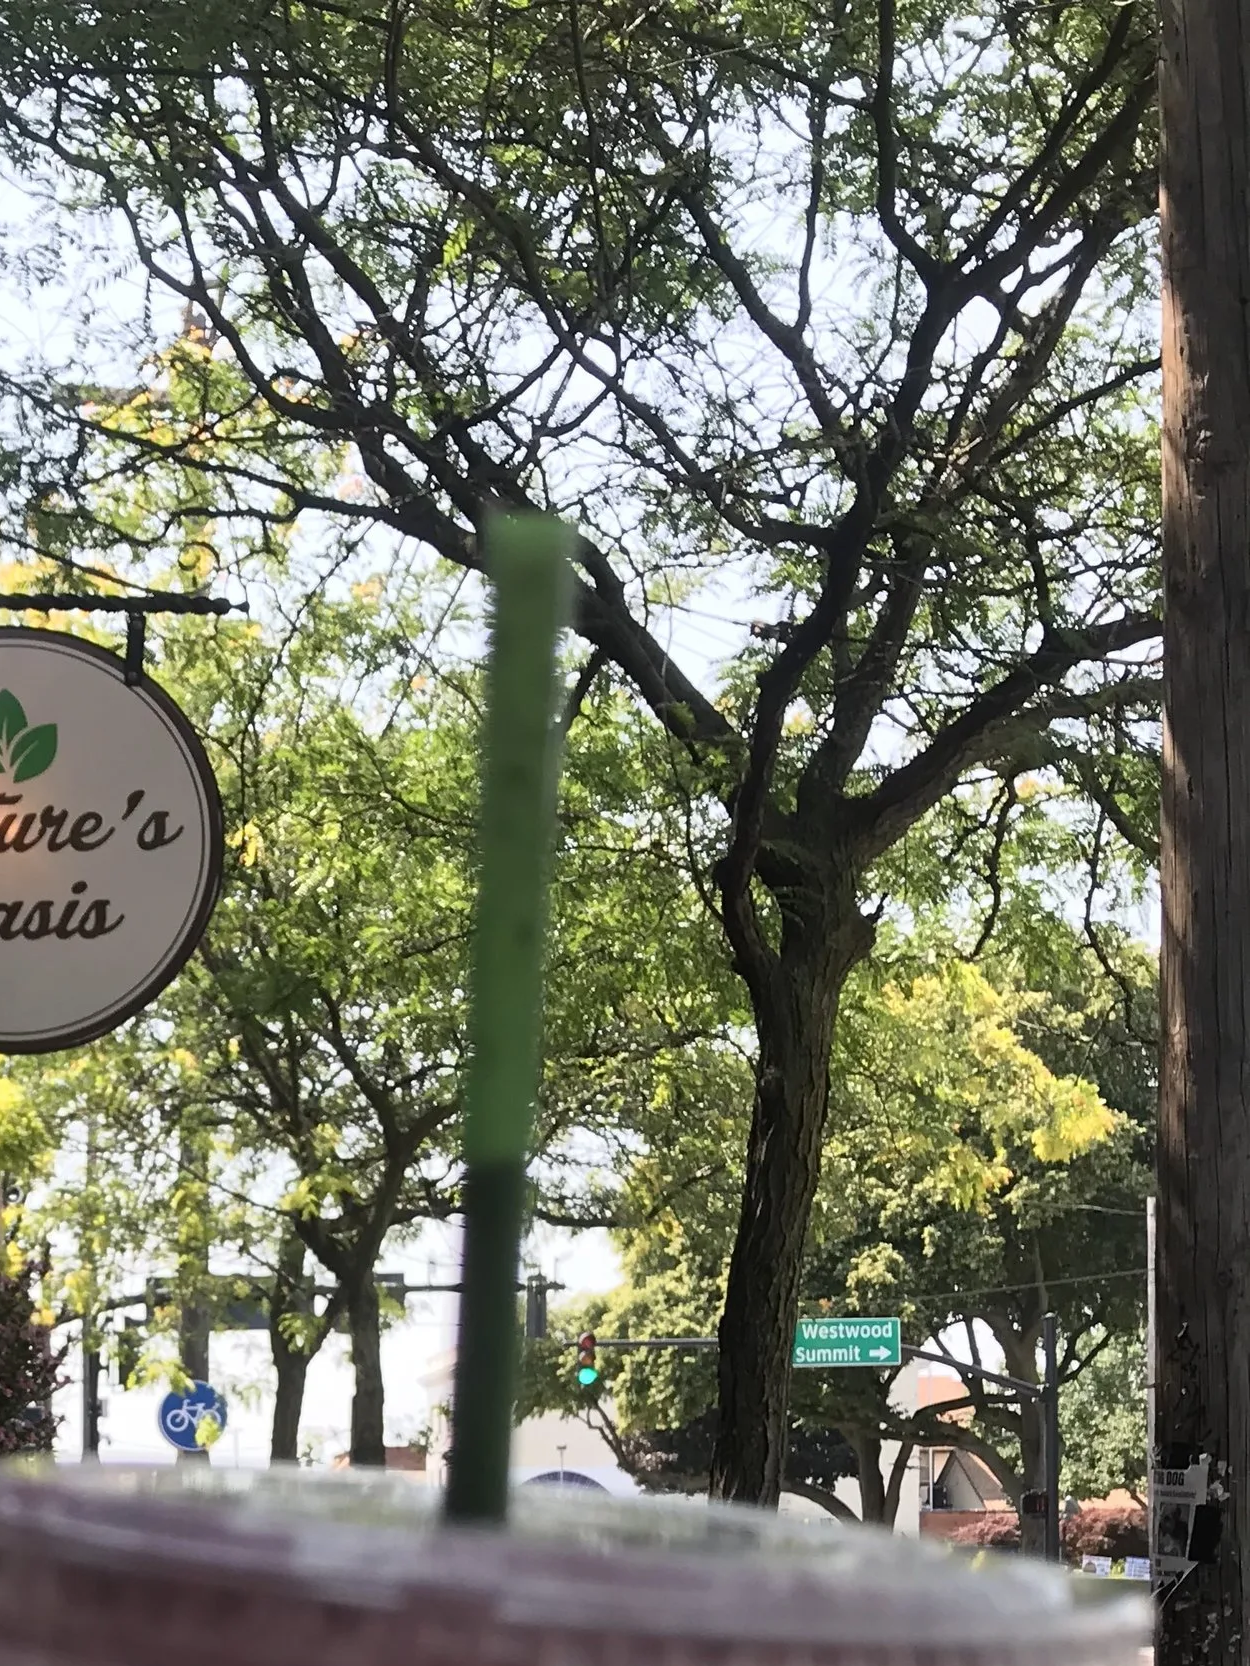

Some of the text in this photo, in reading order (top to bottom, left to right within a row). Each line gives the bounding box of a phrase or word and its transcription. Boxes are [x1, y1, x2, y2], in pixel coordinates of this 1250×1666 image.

[801, 1321, 893, 1340] Westwood
[795, 1345, 861, 1362] Summit
[1166, 1471, 1185, 1486] DOG
